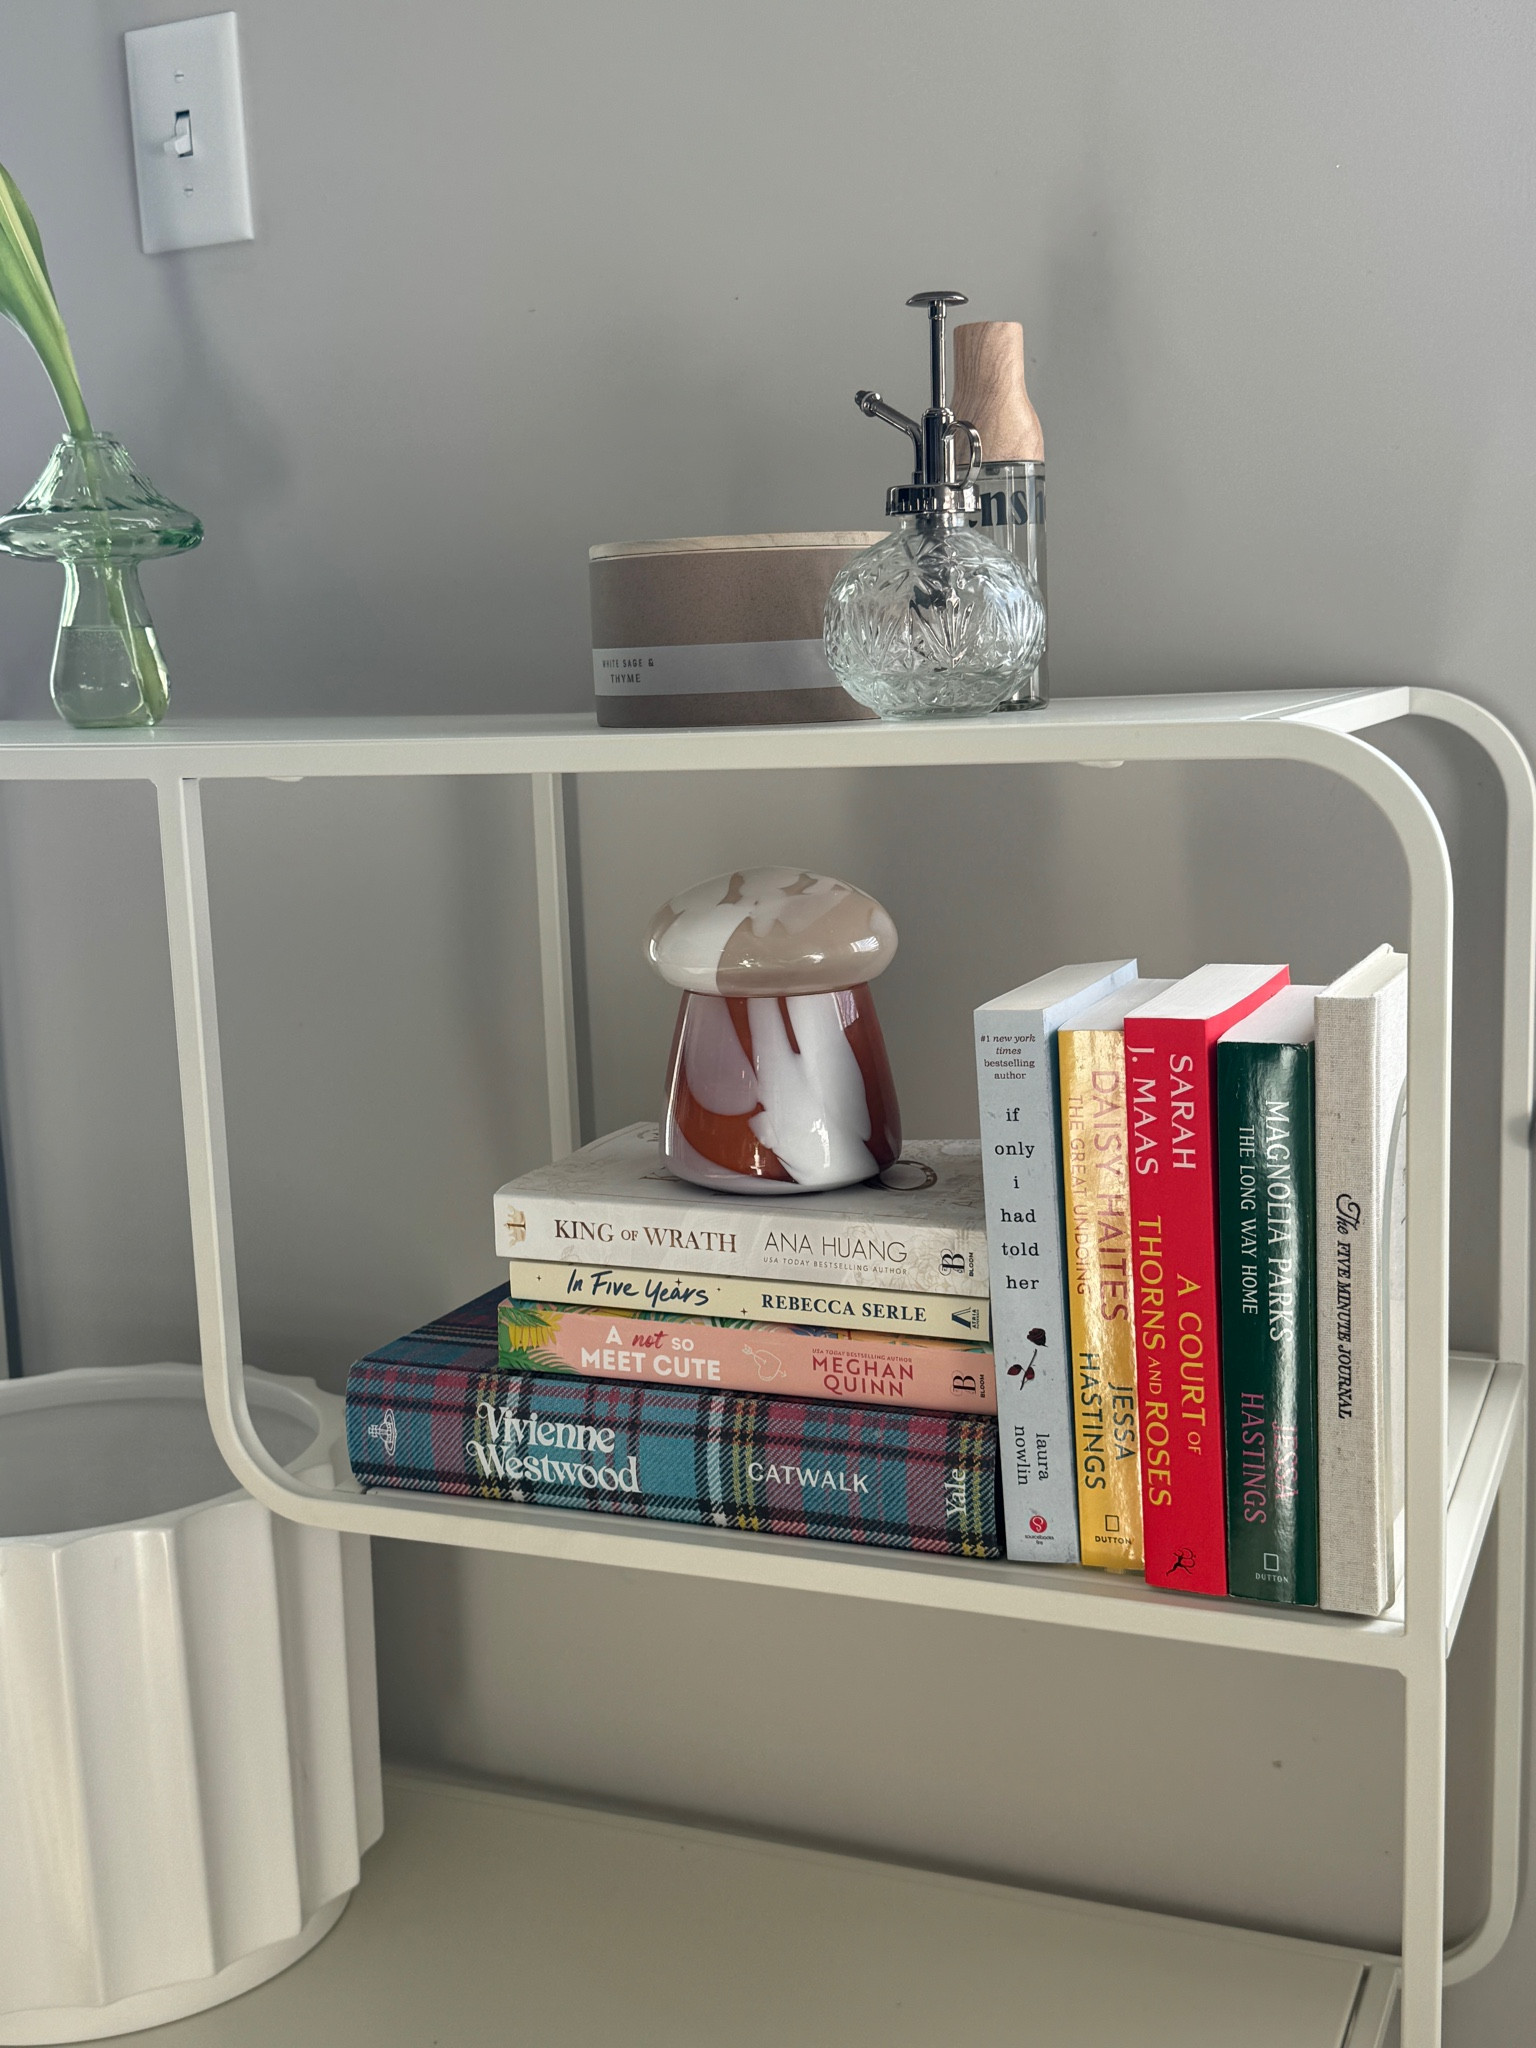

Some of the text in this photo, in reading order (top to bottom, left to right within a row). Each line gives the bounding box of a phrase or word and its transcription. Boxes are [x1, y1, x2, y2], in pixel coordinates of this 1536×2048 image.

[610, 673, 641, 683] THYME
[622, 659, 642, 668] SAGE
[648, 658, 654, 667] &
[980, 1034, 1036, 1045] #1 new york
[995, 1046, 1022, 1055] times
[984, 1058, 1035, 1069] bestselling
[994, 1071, 1026, 1080] author
[1005, 1107, 1020, 1122] if
[1126, 1045, 1159, 1176] J. MAAS
[1169, 1053, 1197, 1170] SARAH
[994, 1141, 1035, 1158] only
[1013, 1175, 1020, 1189] i
[1068, 1095, 1091, 1295] THE GREAT UNDOING
[1091, 1070, 1128, 1322] DAISY HAITES
[1000, 1208, 1037, 1223] had
[1239, 1125, 1259, 1315] THE LONG WAY HOME
[1265, 1100, 1294, 1343] MAGNOLIA PARKS
[554, 1219, 737, 1253] KING OF WRATH
[764, 1231, 908, 1263] ANA HUANG
[1001, 1242, 1040, 1257] told
[783, 1258, 810, 1267] TODAY
[814, 1261, 869, 1272] BESTSELLING
[872, 1266, 908, 1275] AUTHOR
[1006, 1275, 1039, 1290] her
[567, 1268, 709, 1308] In Five Years
[761, 1294, 927, 1322] REBECCA SERLE
[1335, 1193, 1361, 1420] The FIVE MINUTE JOURNAL
[605, 1325, 695, 1351] A not SO
[581, 1347, 721, 1381] MEET CUTE
[812, 1355, 914, 1381] MEGHAN
[846, 1352, 886, 1361] BESTSELLING
[1138, 1215, 1172, 1506] THORNS AND ROSES
[1177, 1273, 1206, 1456] A COURT OF
[823, 1374, 904, 1398] QUINN
[476, 1402, 616, 1453] Vivienne
[1079, 1352, 1106, 1490] HASTINGS
[1108, 1382, 1136, 1461] JESSA
[466, 1440, 642, 1493] Westwood
[1014, 1425, 1031, 1486] nowlin
[1036, 1433, 1050, 1481] laura
[1241, 1392, 1267, 1524] HASTINGS
[1271, 1420, 1299, 1500] JESSA
[748, 1462, 869, 1494] CATWALK
[944, 1468, 967, 1518] Yale
[1095, 1535, 1132, 1545] DUTTON
[1255, 1573, 1289, 1584] DUTTON
